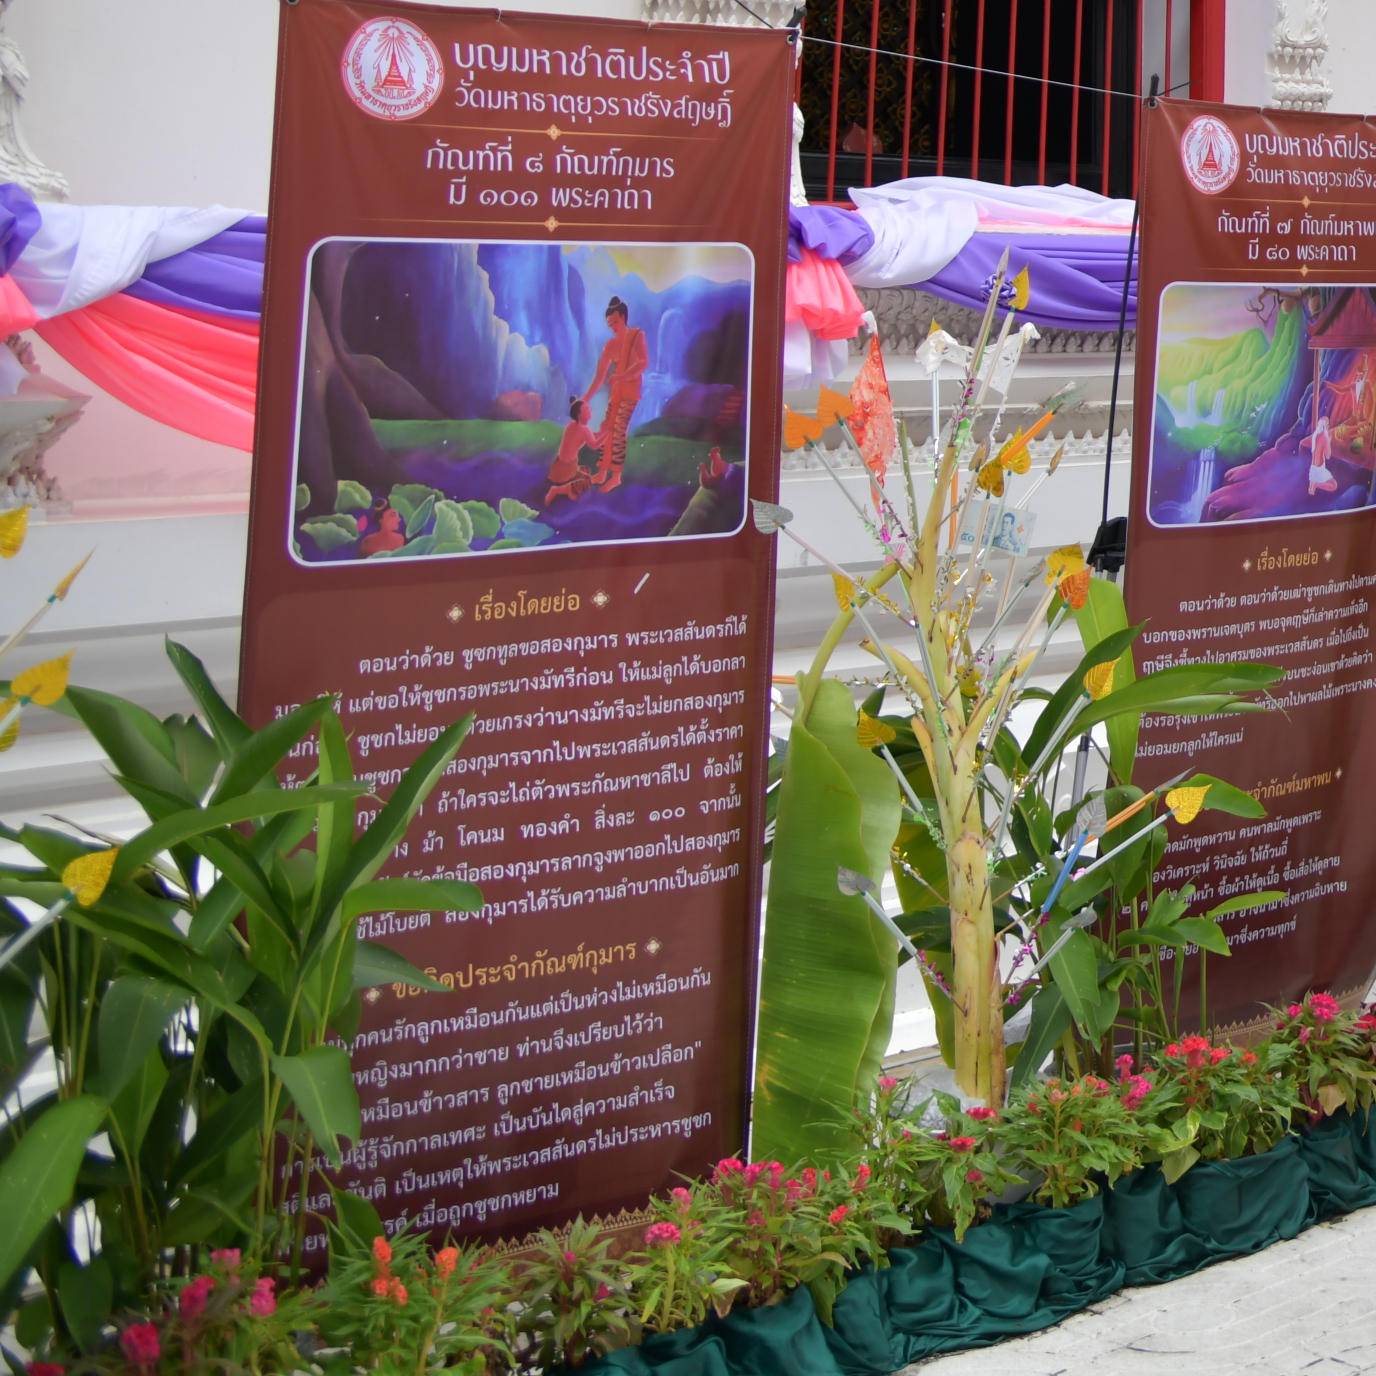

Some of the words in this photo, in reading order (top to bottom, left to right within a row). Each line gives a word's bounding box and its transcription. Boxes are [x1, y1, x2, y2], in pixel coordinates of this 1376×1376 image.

[453, 41, 731, 84] บุญมหาชาติประจำปี
[454, 81, 734, 128] วัดมหาธาตุยุวราชรังสฤษฎิ์
[426, 136, 514, 172] กัณฑ์ที่
[526, 153, 543, 173] ๘
[555, 145, 675, 186] กัณฑ์กุมาร
[448, 176, 467, 206] มี
[479, 187, 539, 207] ๑๐๑
[551, 184, 653, 210] พระคาถา
[1217, 206, 1270, 234] กัณฑ์ที่
[1248, 238, 1259, 260] มี
[1266, 245, 1290, 261] ๘๐
[1297, 242, 1356, 262] พระคาถา
[1257, 546, 1319, 571] เรื่องโดยย่อ
[474, 588, 581, 622] เรื่องโดยย่อ
[1179, 592, 1237, 613] ตอนว่าด้วย
[359, 645, 455, 674] ตอนว่าด้วย
[626, 615, 748, 647] พระเวสสันดรก็ได้
[619, 654, 746, 685] ให้แม่ลูกได้บอกลา
[358, 723, 447, 756] ชูชกไม่ยอ
[703, 752, 744, 779] ต้องให้
[422, 830, 443, 853] ม้า
[457, 824, 505, 847] โคนม
[521, 813, 580, 839] ทองคำ
[595, 804, 635, 830] สิ่งละ
[649, 807, 686, 822] ๑๐๐
[699, 783, 742, 815] จากนั้น
[1153, 855, 1211, 883] องวิเคราะห์
[517, 1012, 663, 1058] ท่านจึงเปรียบไว้ว่า
[361, 1087, 489, 1123] หมือนข้าวสาร
[494, 1078, 675, 1137] เป็นบันไดสู่ความสำเร็จ
